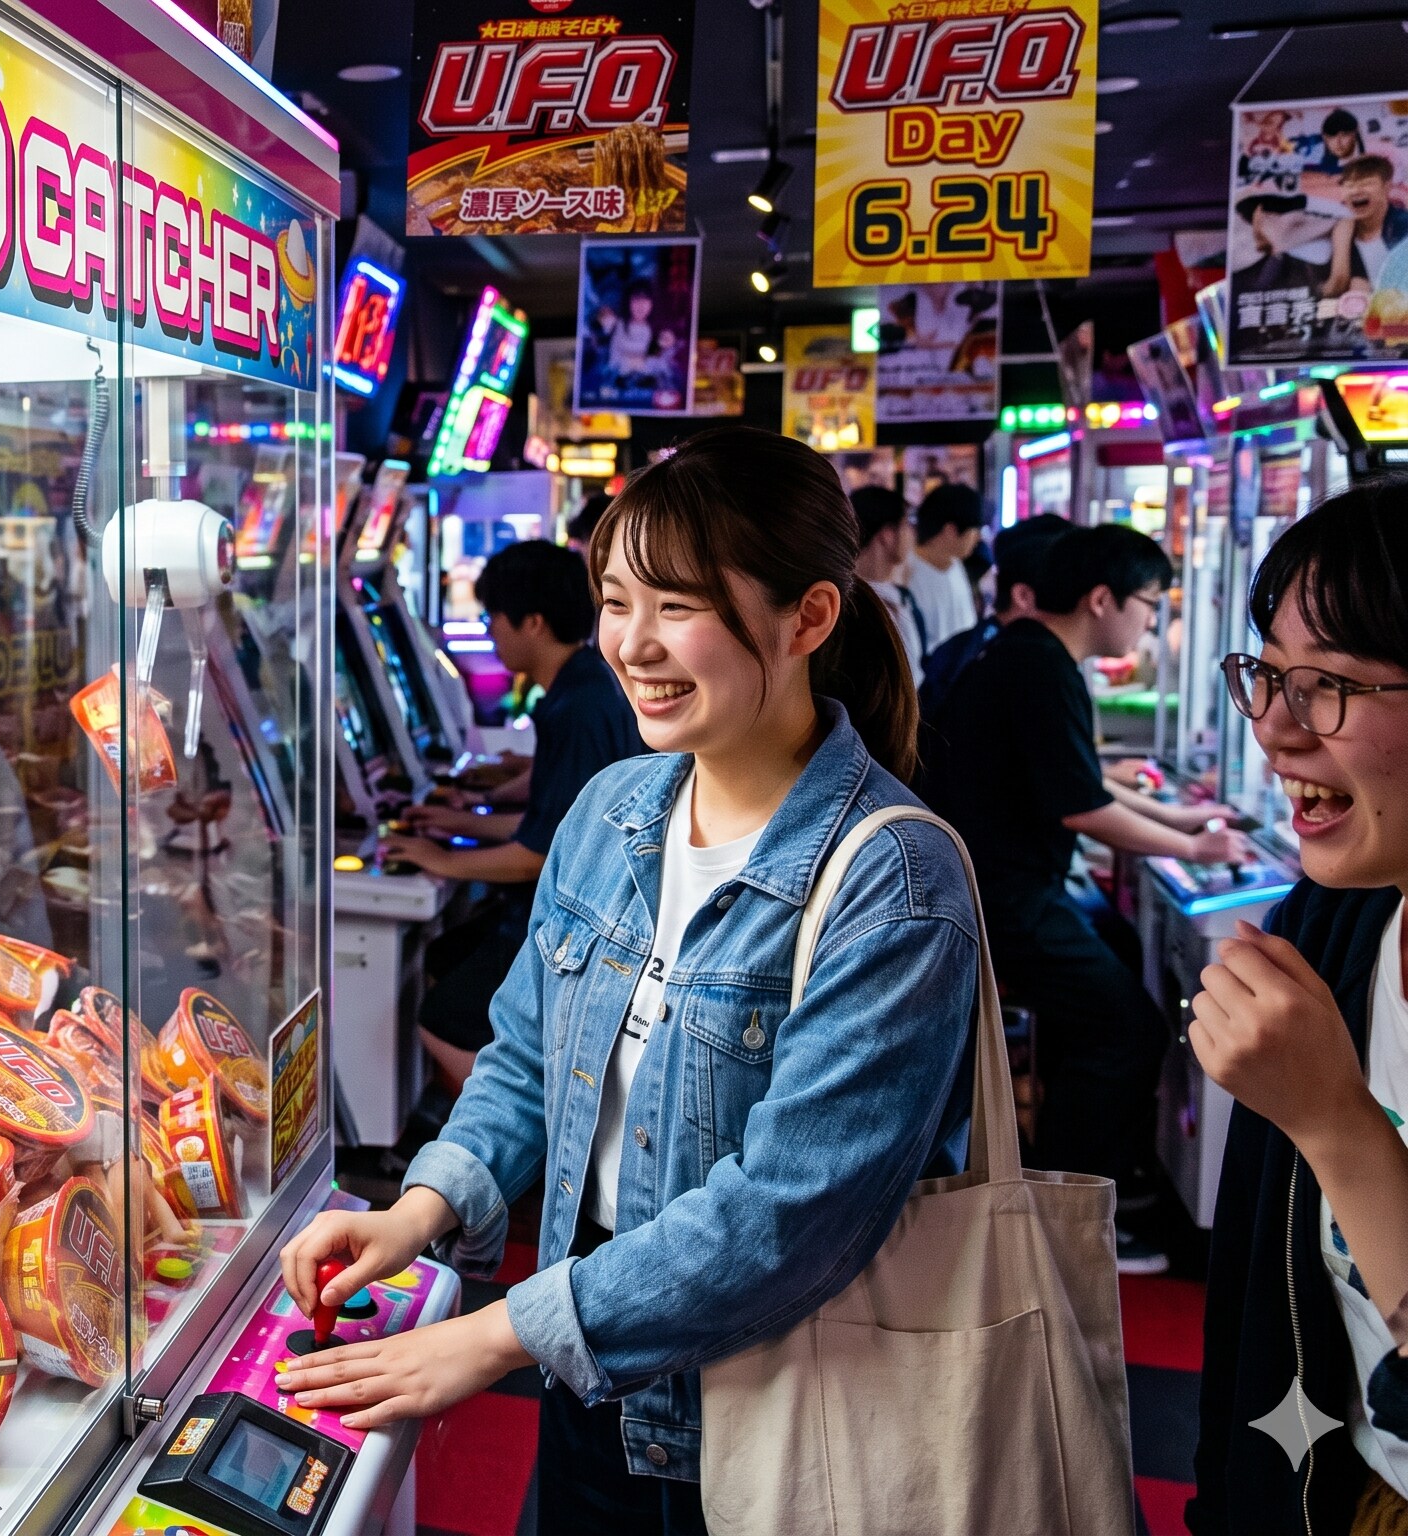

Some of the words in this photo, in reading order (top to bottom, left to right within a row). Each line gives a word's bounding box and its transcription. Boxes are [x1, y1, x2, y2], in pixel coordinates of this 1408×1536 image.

[890, 109, 1020, 164] Day
[22, 127, 279, 345] CATCHER
[461, 187, 624, 220] 濃厚ソース味
[851, 175, 1052, 258] 6.24
